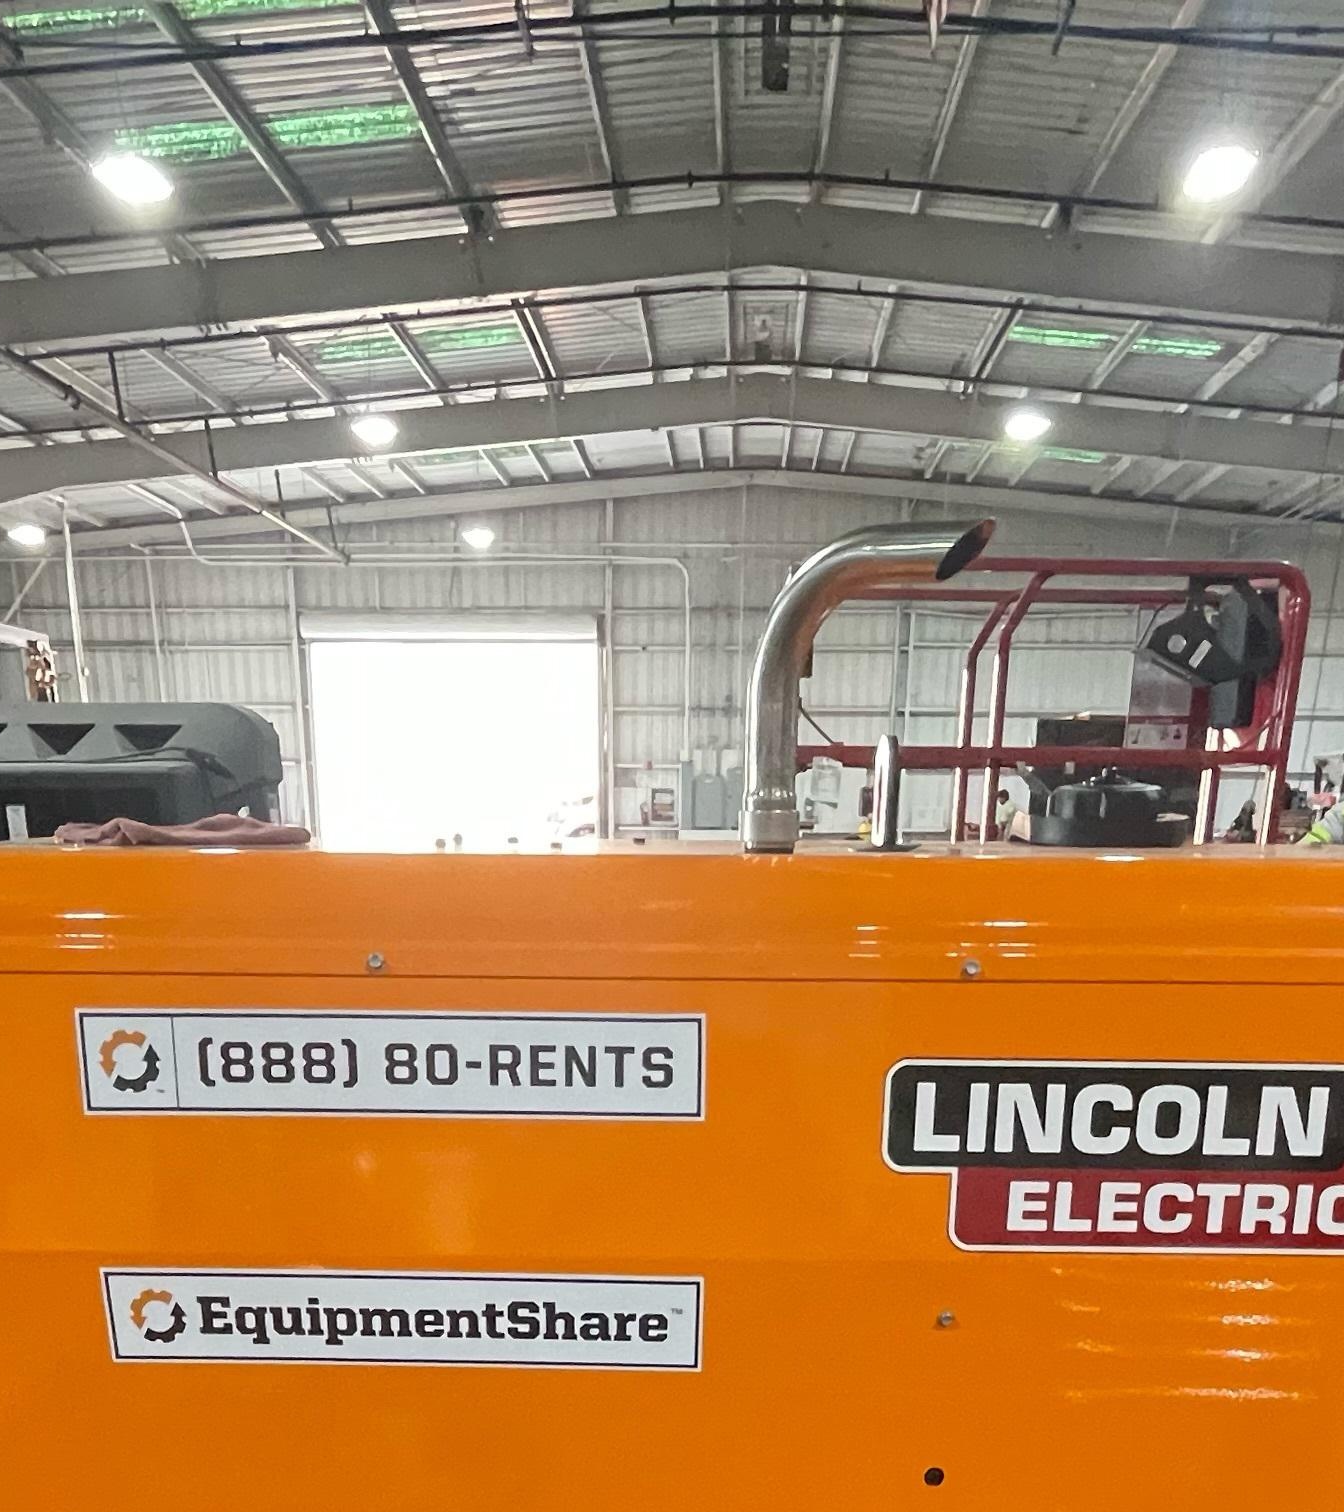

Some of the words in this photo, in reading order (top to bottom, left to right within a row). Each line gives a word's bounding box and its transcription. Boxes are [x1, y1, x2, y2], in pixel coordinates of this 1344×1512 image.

[197, 1037, 359, 1089] (888)
[384, 1041, 676, 1090] 80-RENTS
[912, 1081, 1330, 1157] LINCOLN
[196, 1295, 670, 1346] EquipmentShare
